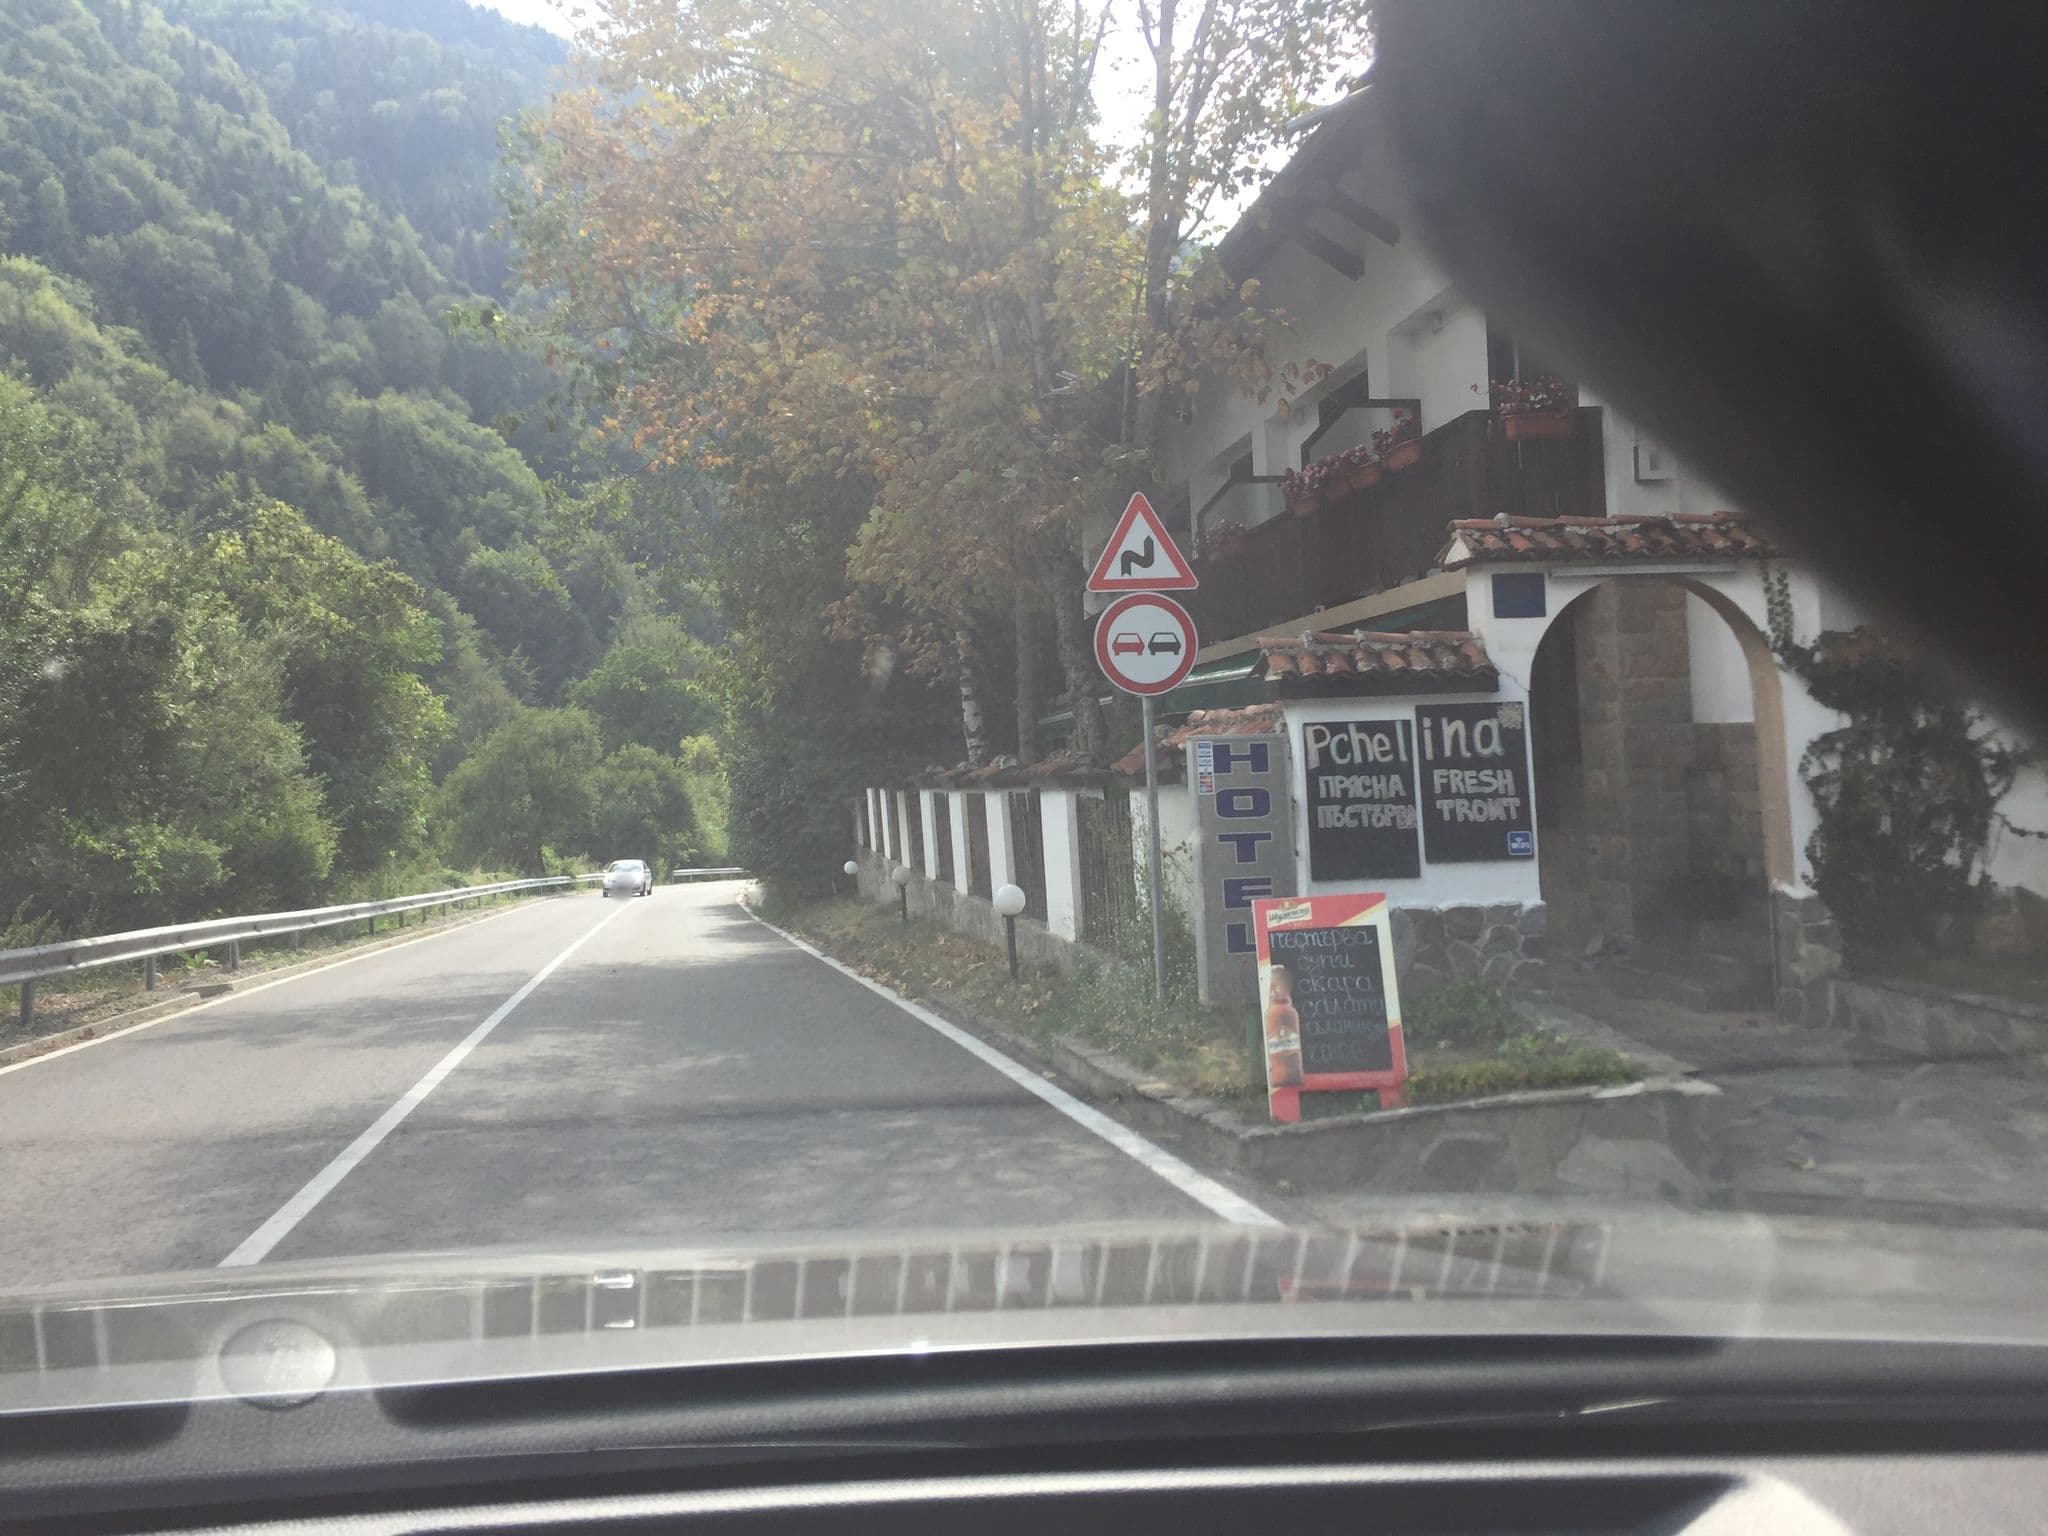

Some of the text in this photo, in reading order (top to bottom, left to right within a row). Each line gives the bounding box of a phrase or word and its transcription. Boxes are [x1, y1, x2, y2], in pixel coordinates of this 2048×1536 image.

[1319, 774, 1407, 800] ПРЯСНА
[1432, 769, 1515, 796] FRESH
[1212, 741, 1272, 954] HOTEL
